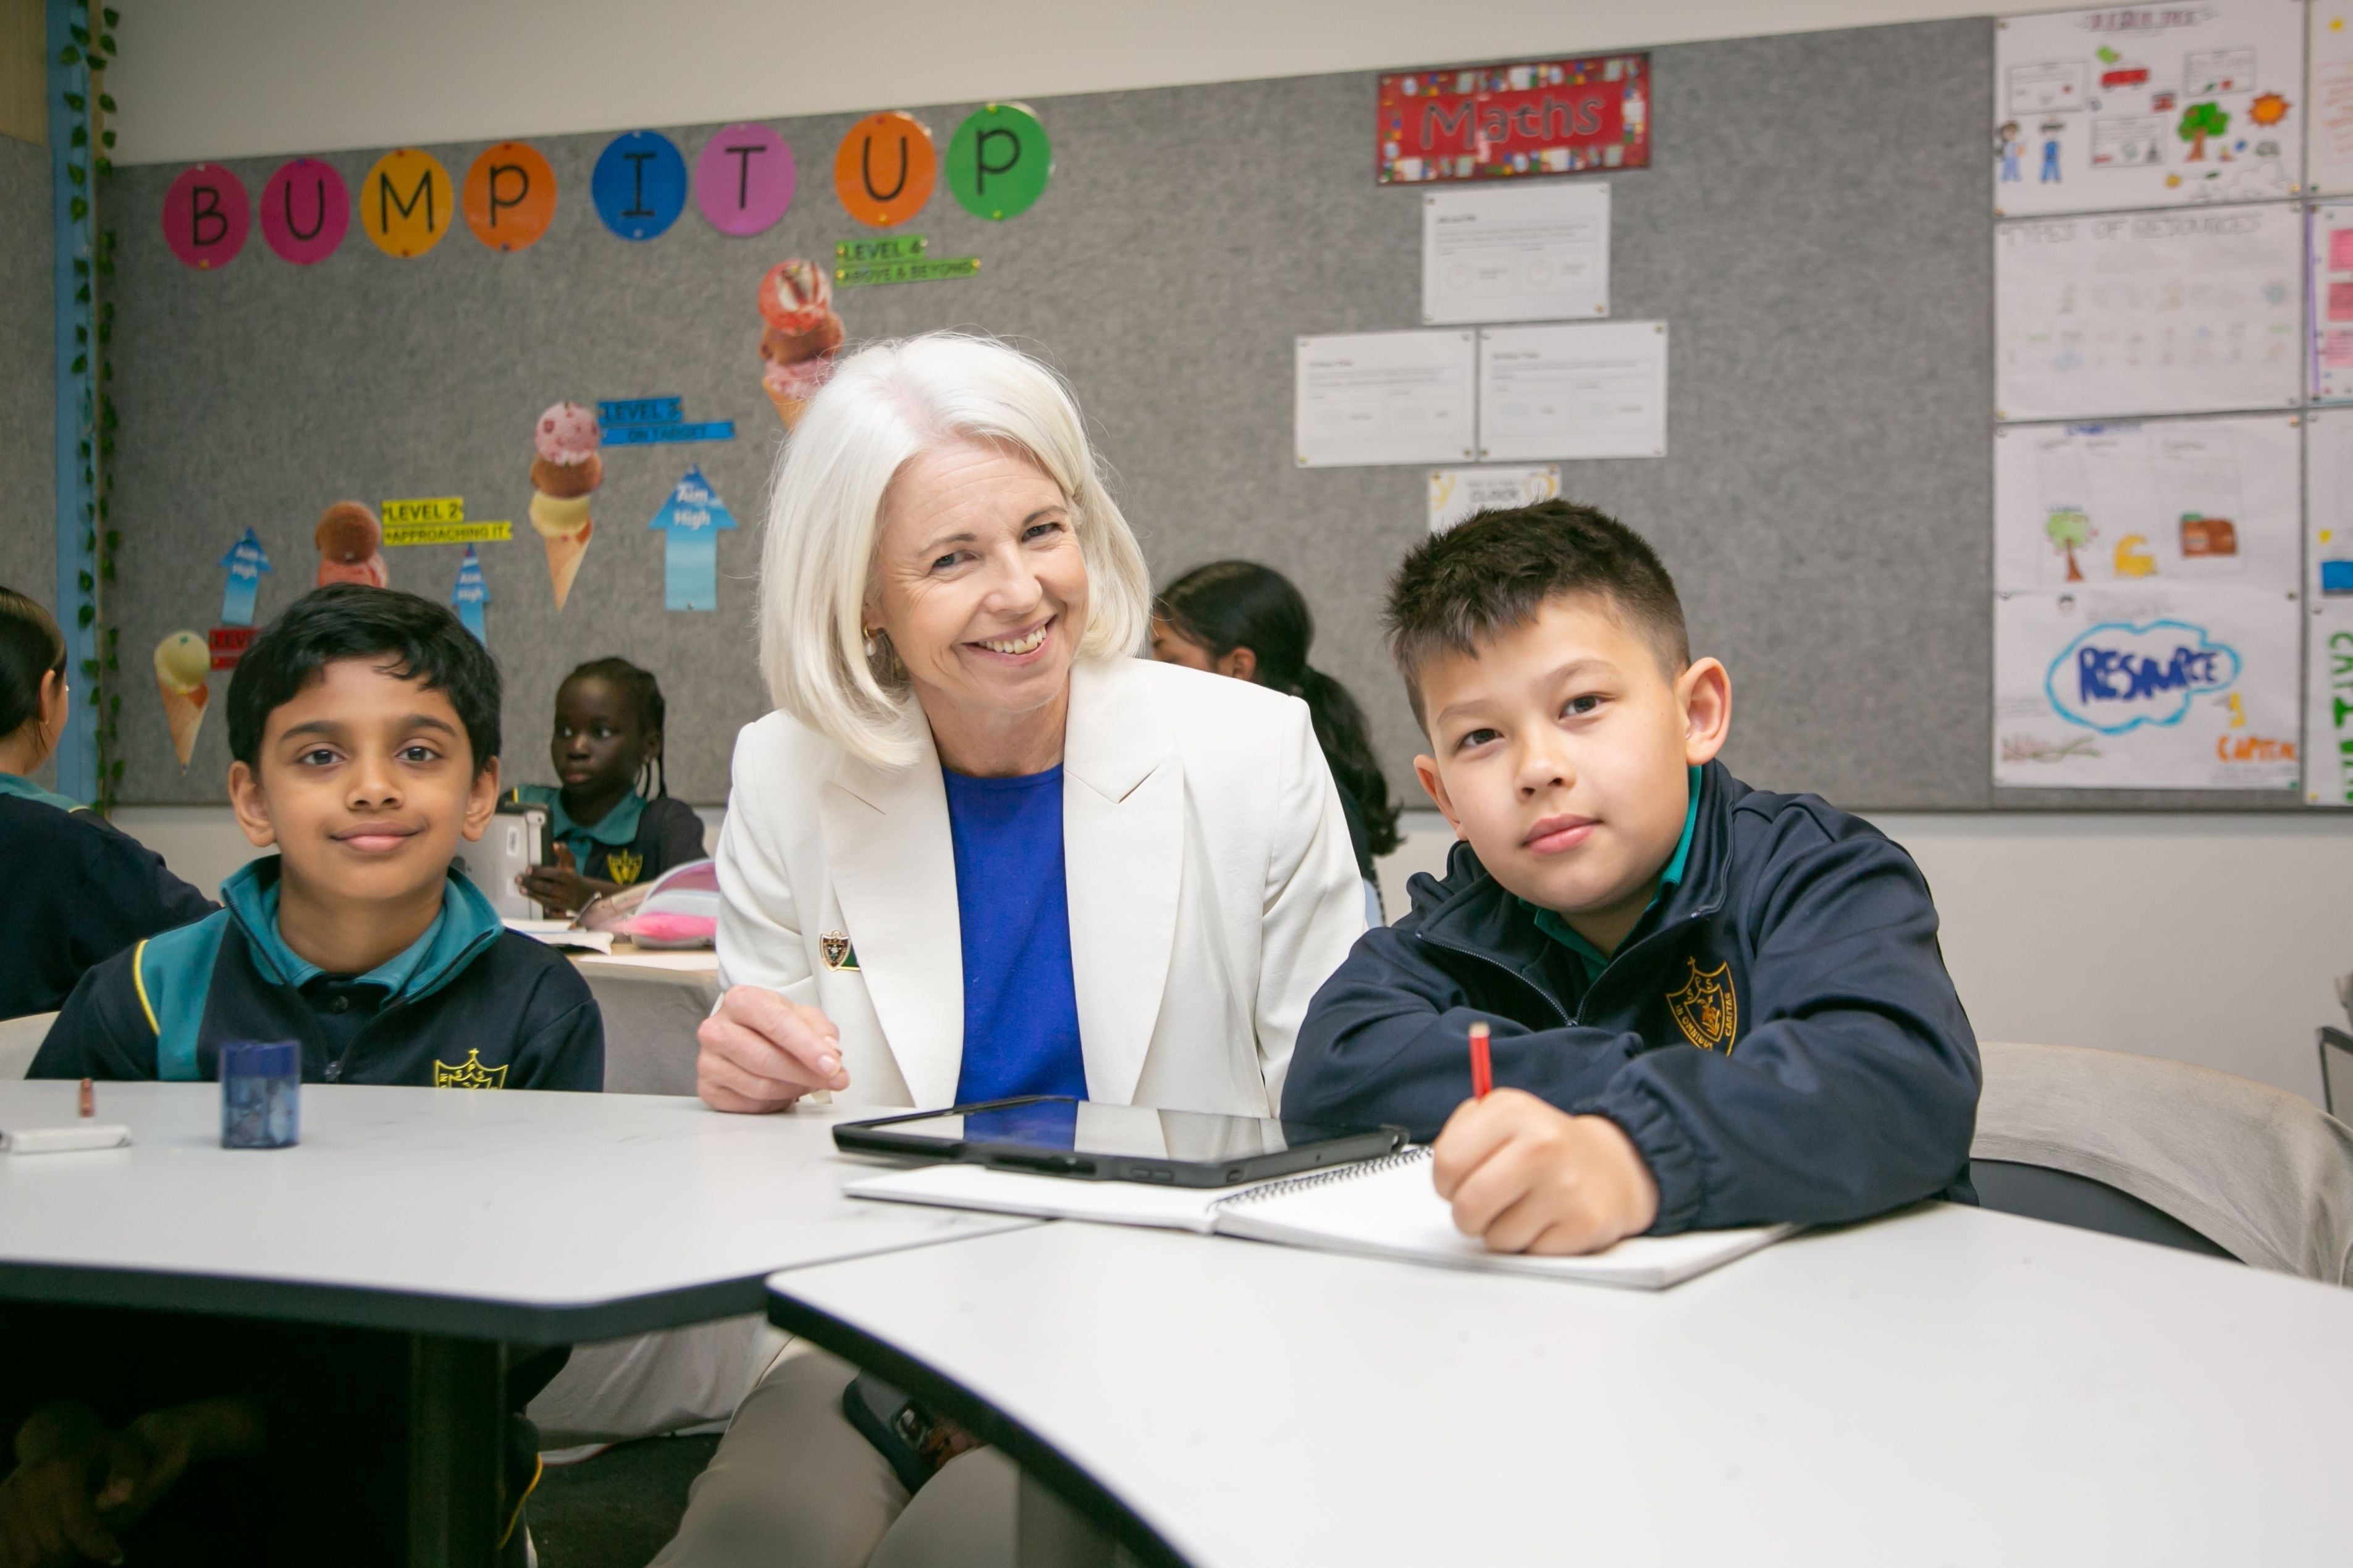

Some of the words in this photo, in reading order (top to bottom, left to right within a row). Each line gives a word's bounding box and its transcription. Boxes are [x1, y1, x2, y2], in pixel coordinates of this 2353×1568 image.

[1421, 94, 1604, 150] Maths
[193, 164, 529, 246] BUMP
[621, 145, 767, 217] IT
[863, 128, 1022, 202] UP
[844, 241, 903, 262] LEVEL
[605, 402, 659, 421] LEVEL
[388, 504, 444, 521] LEVEL
[449, 503, 459, 518] 2
[674, 510, 710, 530] High
[392, 527, 489, 544] APPROACHING
[492, 527, 505, 537] IT
[1675, 1005, 1683, 1015] IN
[1724, 992, 1733, 1037] CARITAS
[1682, 1017, 1714, 1052] OMNIBUS
